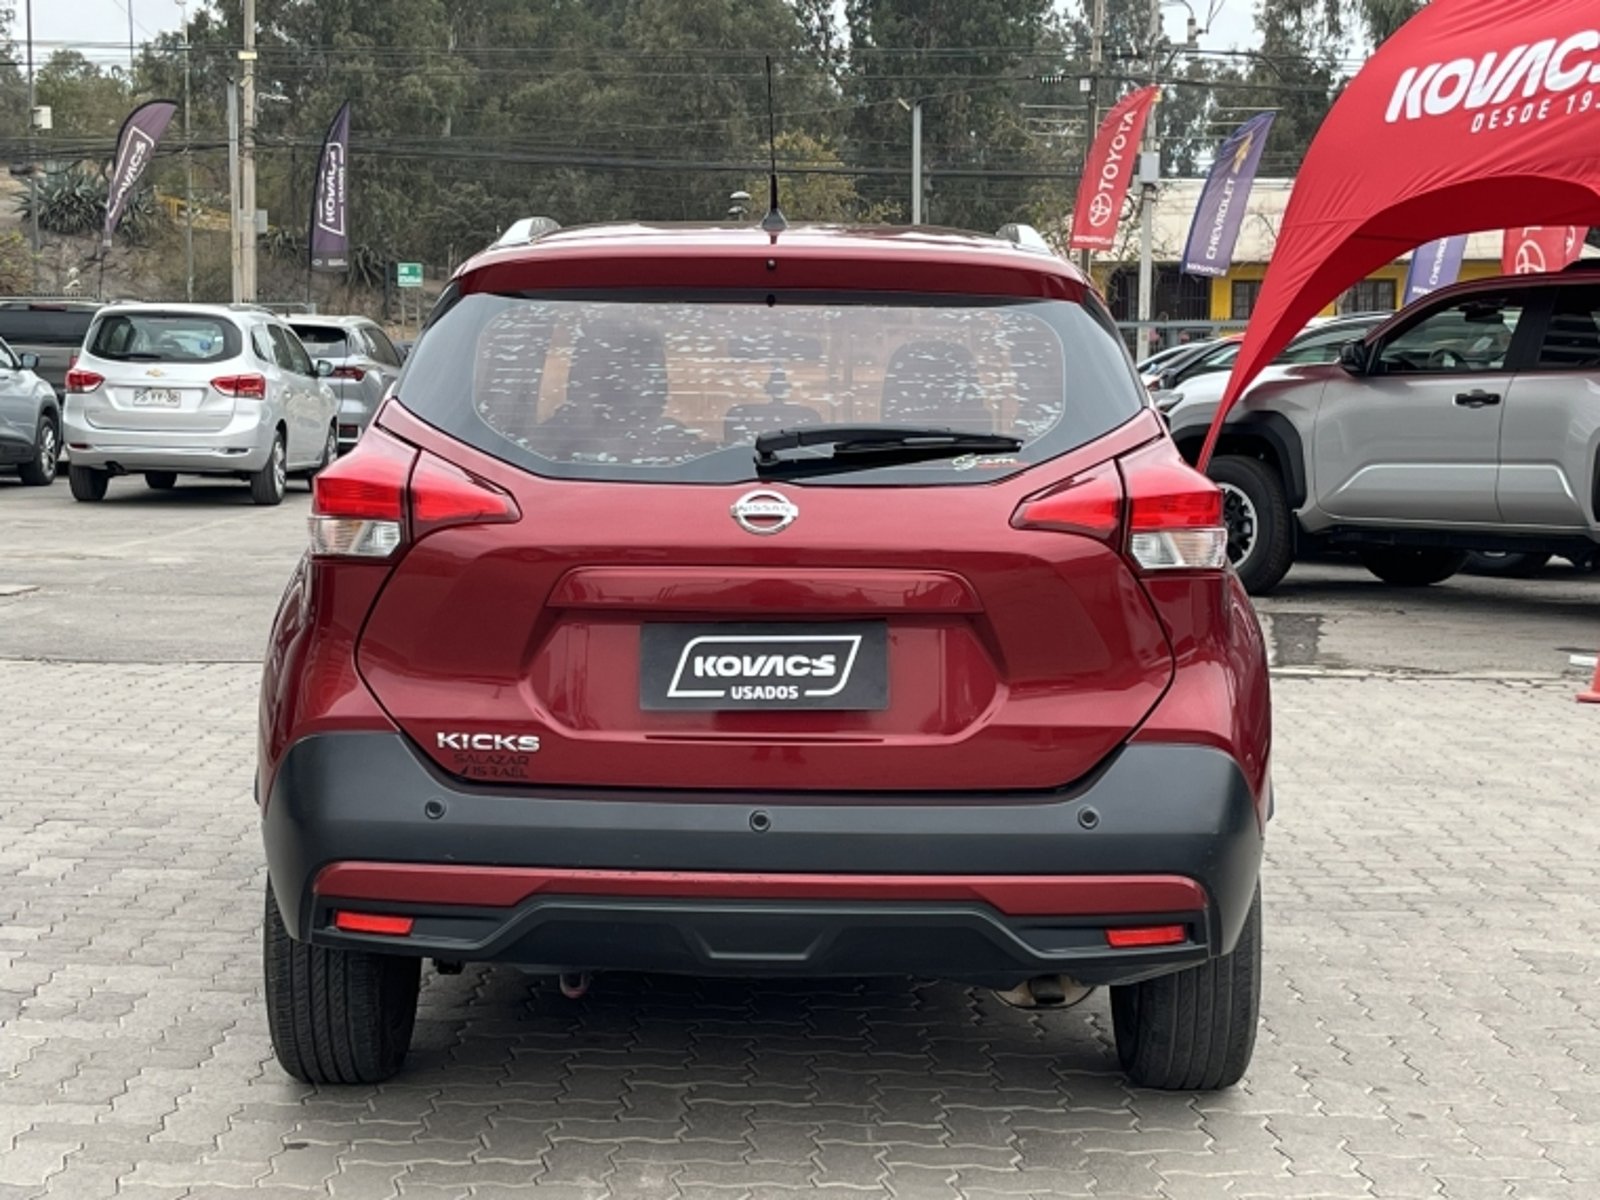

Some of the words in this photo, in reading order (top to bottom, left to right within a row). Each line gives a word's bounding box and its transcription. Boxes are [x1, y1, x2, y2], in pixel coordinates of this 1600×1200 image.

[1384, 30, 1600, 123] KOVAC
[1471, 99, 1551, 133] DESDE
[1099, 110, 1137, 191] TOYOTA
[1206, 177, 1236, 260] CHEVROLET
[738, 504, 791, 513] NISSAN
[693, 655, 836, 677] KOVACS
[730, 686, 800, 700] USADOS
[436, 732, 540, 752] KICKS
[454, 754, 530, 765] SALAZAR
